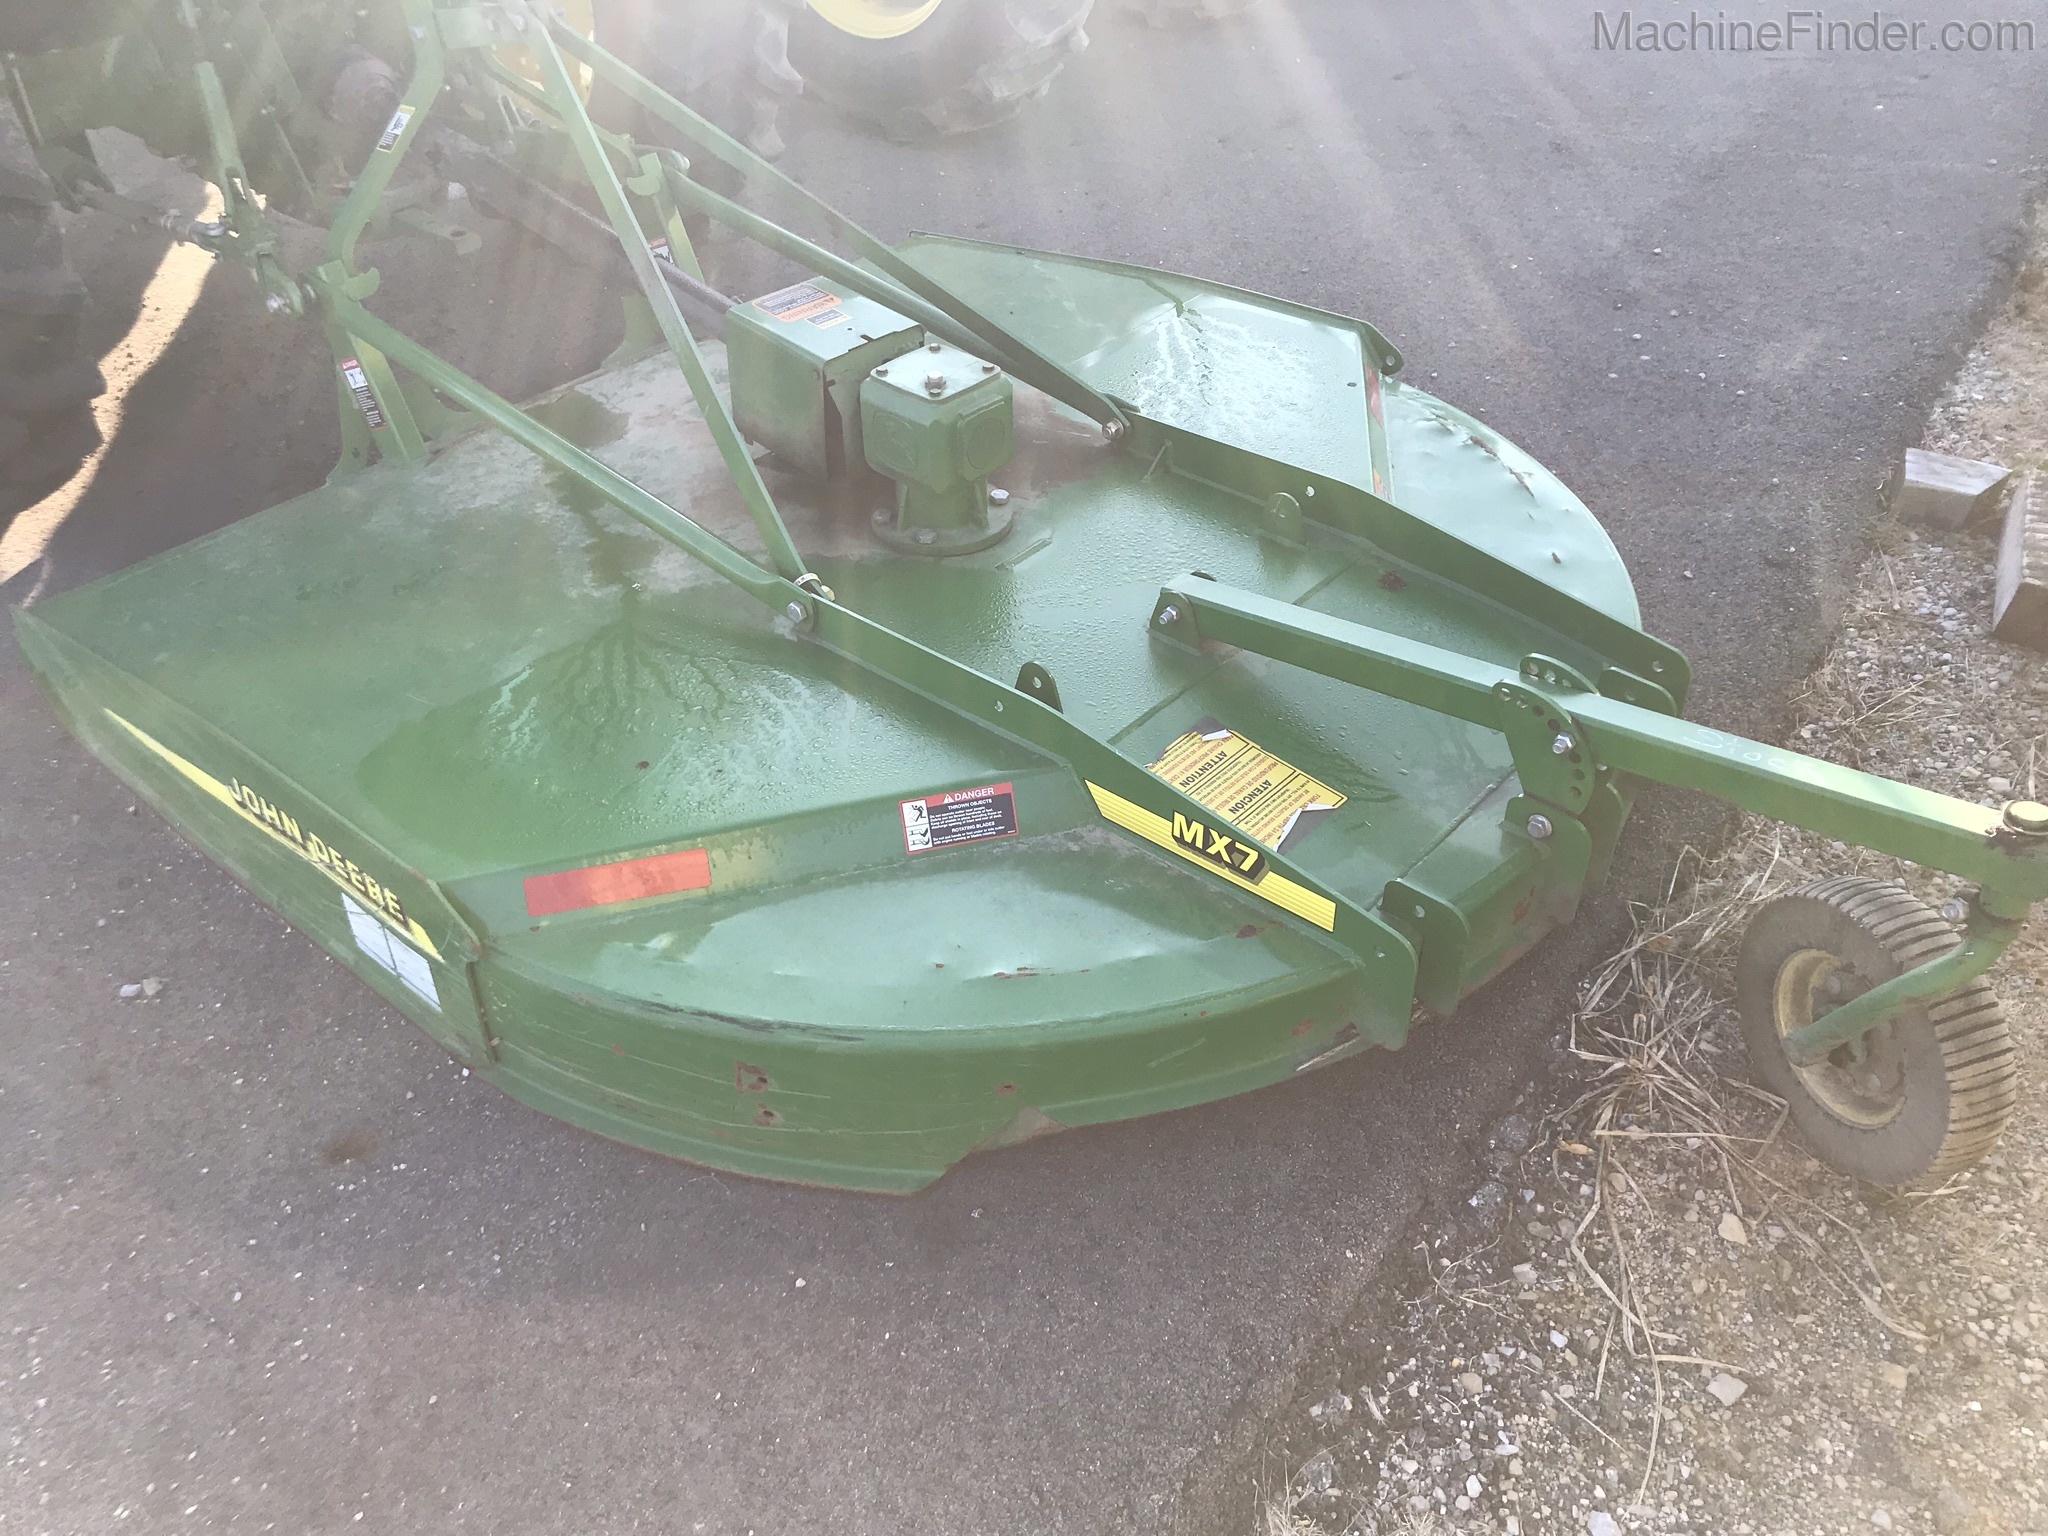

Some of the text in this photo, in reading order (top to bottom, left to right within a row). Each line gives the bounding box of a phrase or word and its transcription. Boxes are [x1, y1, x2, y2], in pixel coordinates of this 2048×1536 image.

[1179, 751, 1228, 787] ATTENTION
[228, 776, 305, 844] JOHN
[954, 788, 994, 801] DANGER
[970, 798, 992, 806] OBJECTS
[1228, 779, 1272, 814] ATENCIÓN
[952, 825, 976, 833] ROTATING
[1173, 812, 1262, 874] MX7
